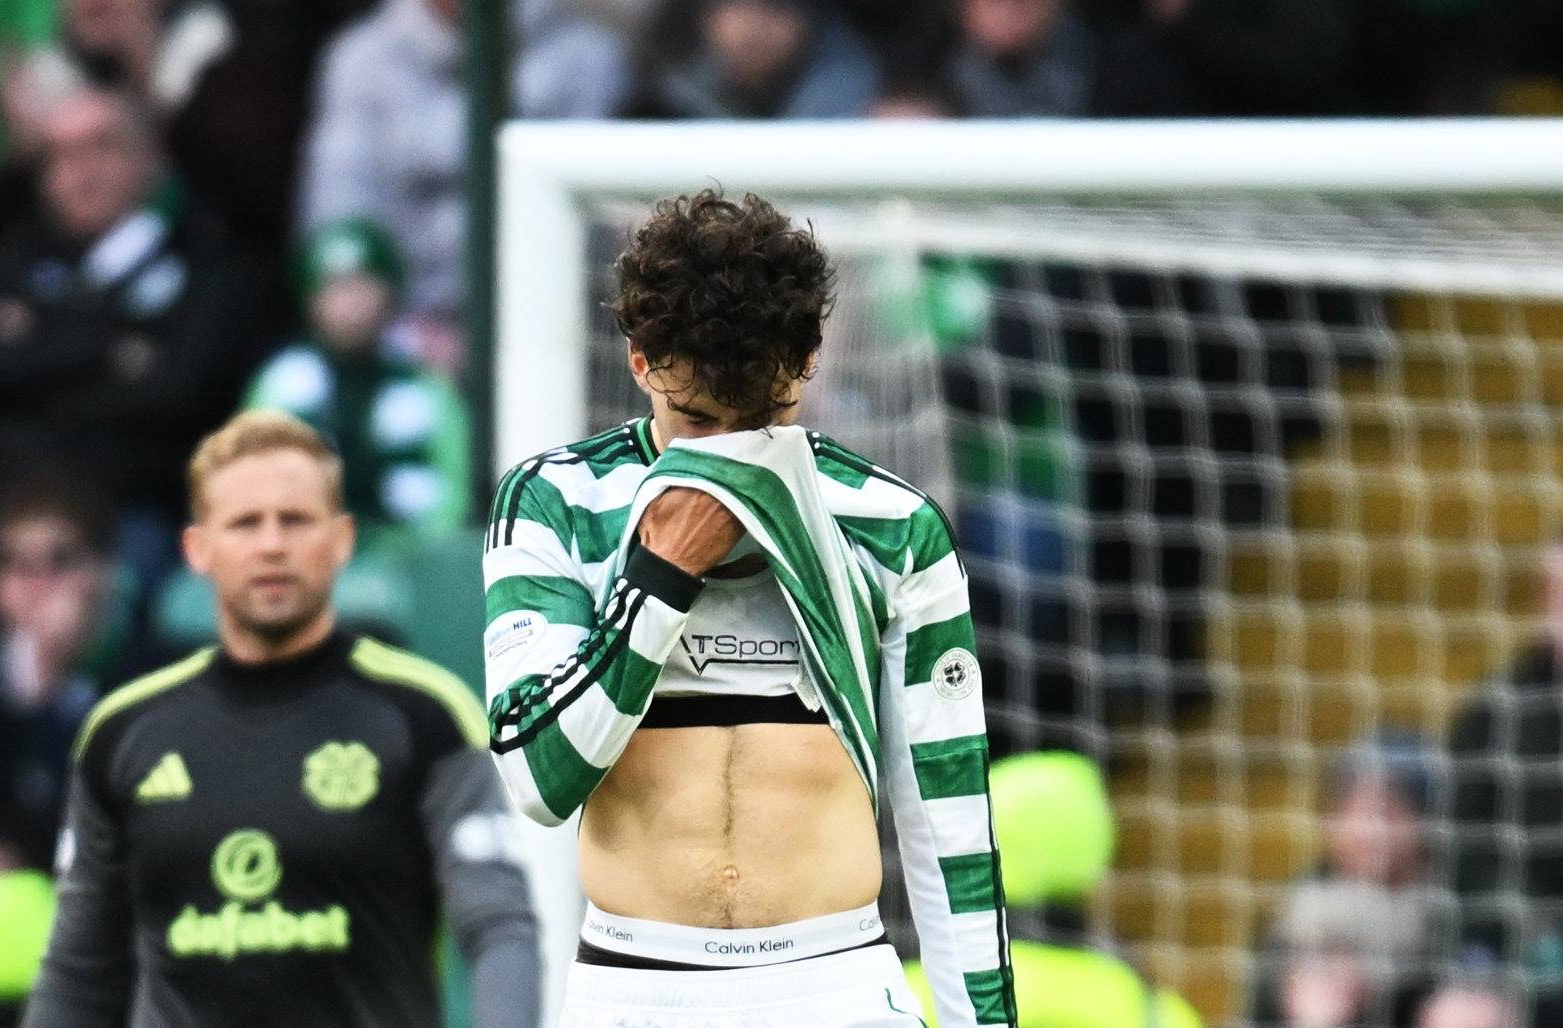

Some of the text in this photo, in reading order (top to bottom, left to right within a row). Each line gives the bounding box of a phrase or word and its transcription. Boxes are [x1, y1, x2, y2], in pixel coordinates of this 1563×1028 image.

[605, 925, 634, 942] Klein
[704, 937, 794, 954] Calvin Klein
